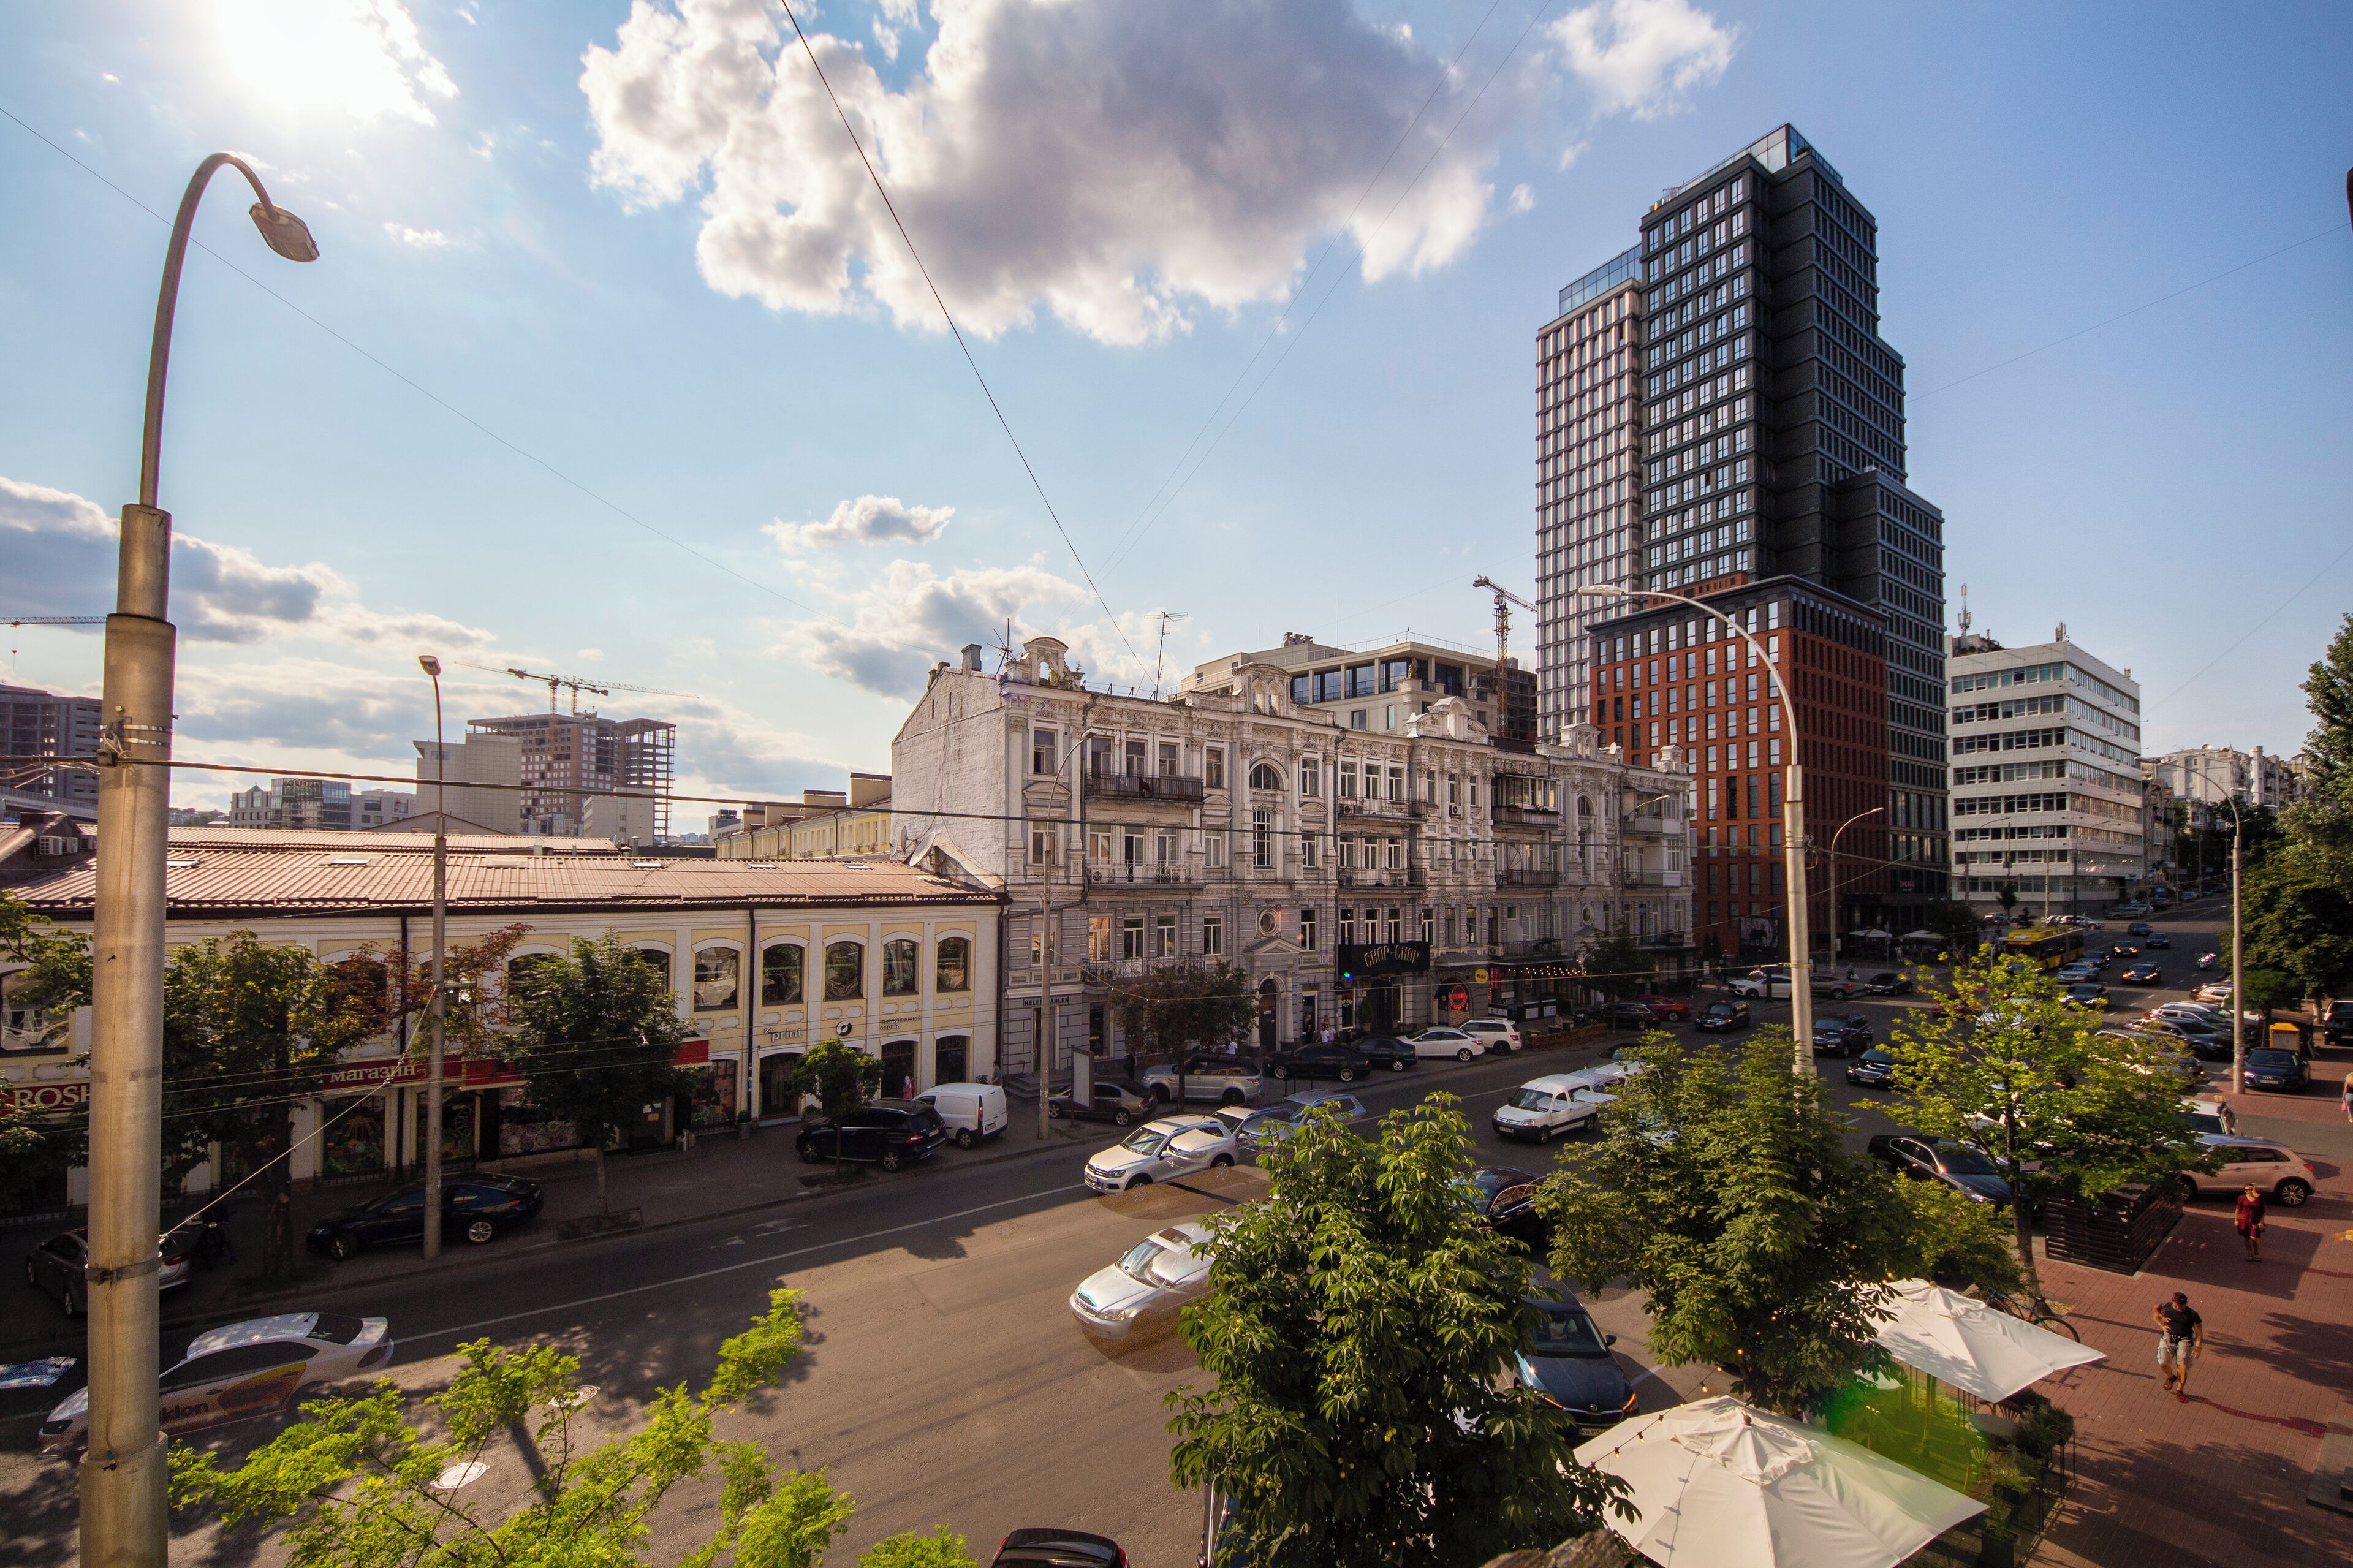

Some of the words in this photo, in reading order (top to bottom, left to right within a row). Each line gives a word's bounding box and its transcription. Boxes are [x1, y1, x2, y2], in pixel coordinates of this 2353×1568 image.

[1364, 945, 1419, 968] CHOP-CHOP
[1050, 996, 1069, 1005] ARLEN
[771, 1028, 803, 1043] print
[330, 1064, 416, 1083] магазин
[159, 1403, 209, 1423] klon
